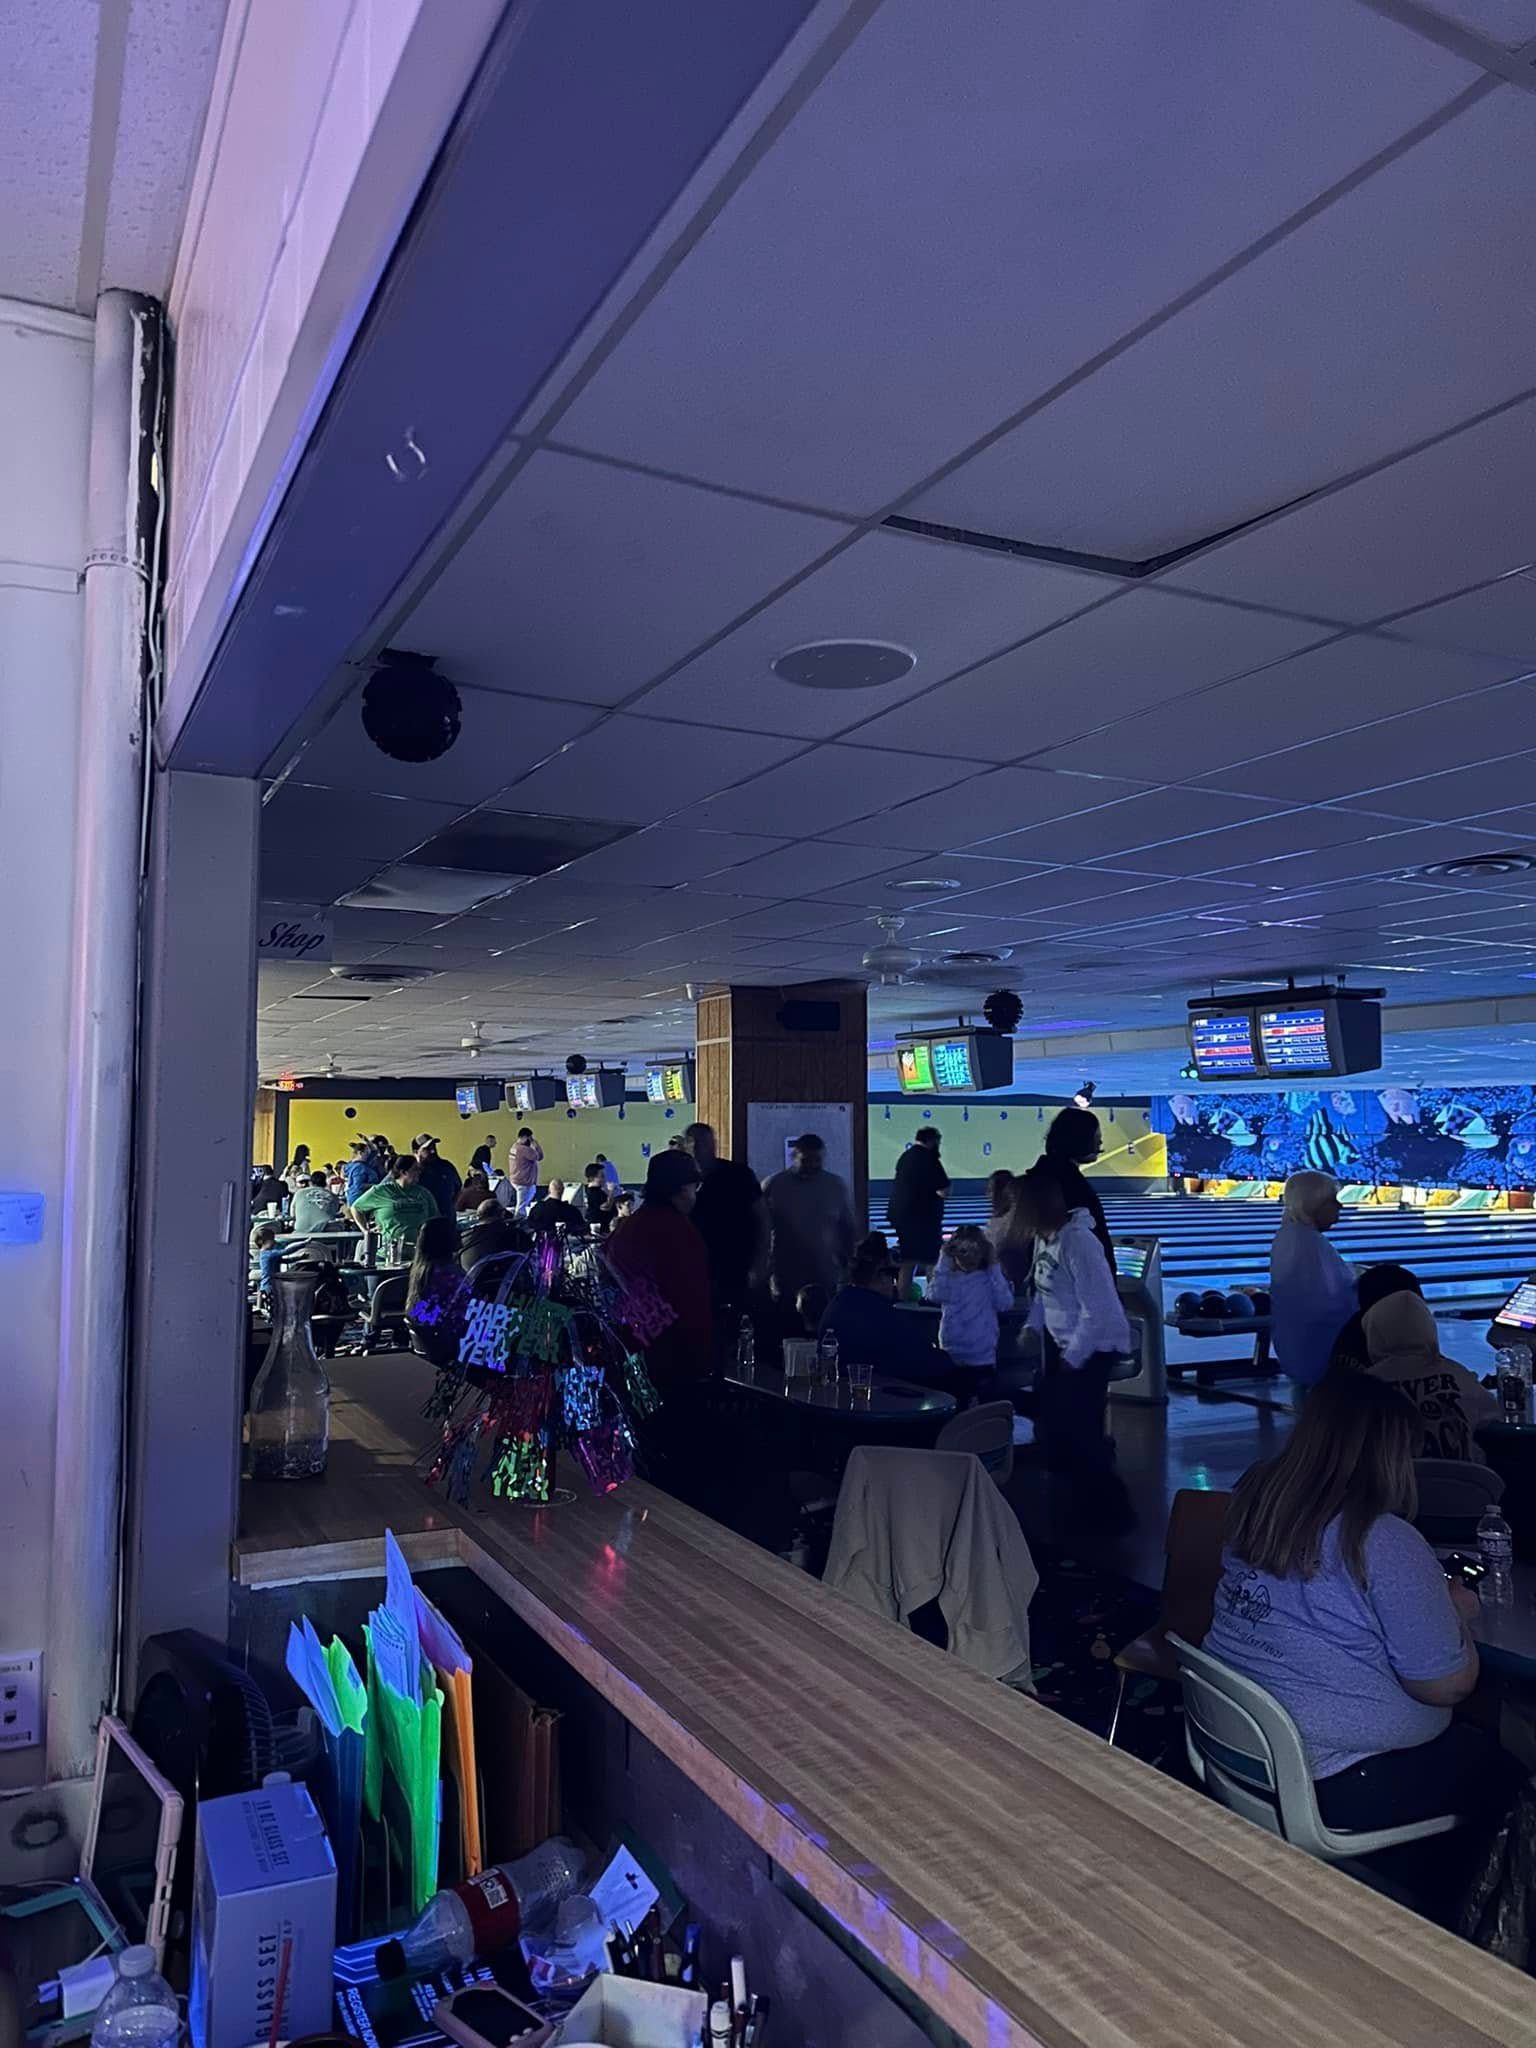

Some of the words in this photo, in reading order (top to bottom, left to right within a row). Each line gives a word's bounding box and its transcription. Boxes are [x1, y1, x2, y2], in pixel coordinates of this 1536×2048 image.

[258, 922, 325, 957] Shop
[1391, 1373, 1460, 1403] VER
[271, 1850, 290, 1866] SET
[258, 1935, 277, 1967] SET
[255, 1977, 275, 2038] GLASS
[346, 1987, 371, 2030] REGISTER
